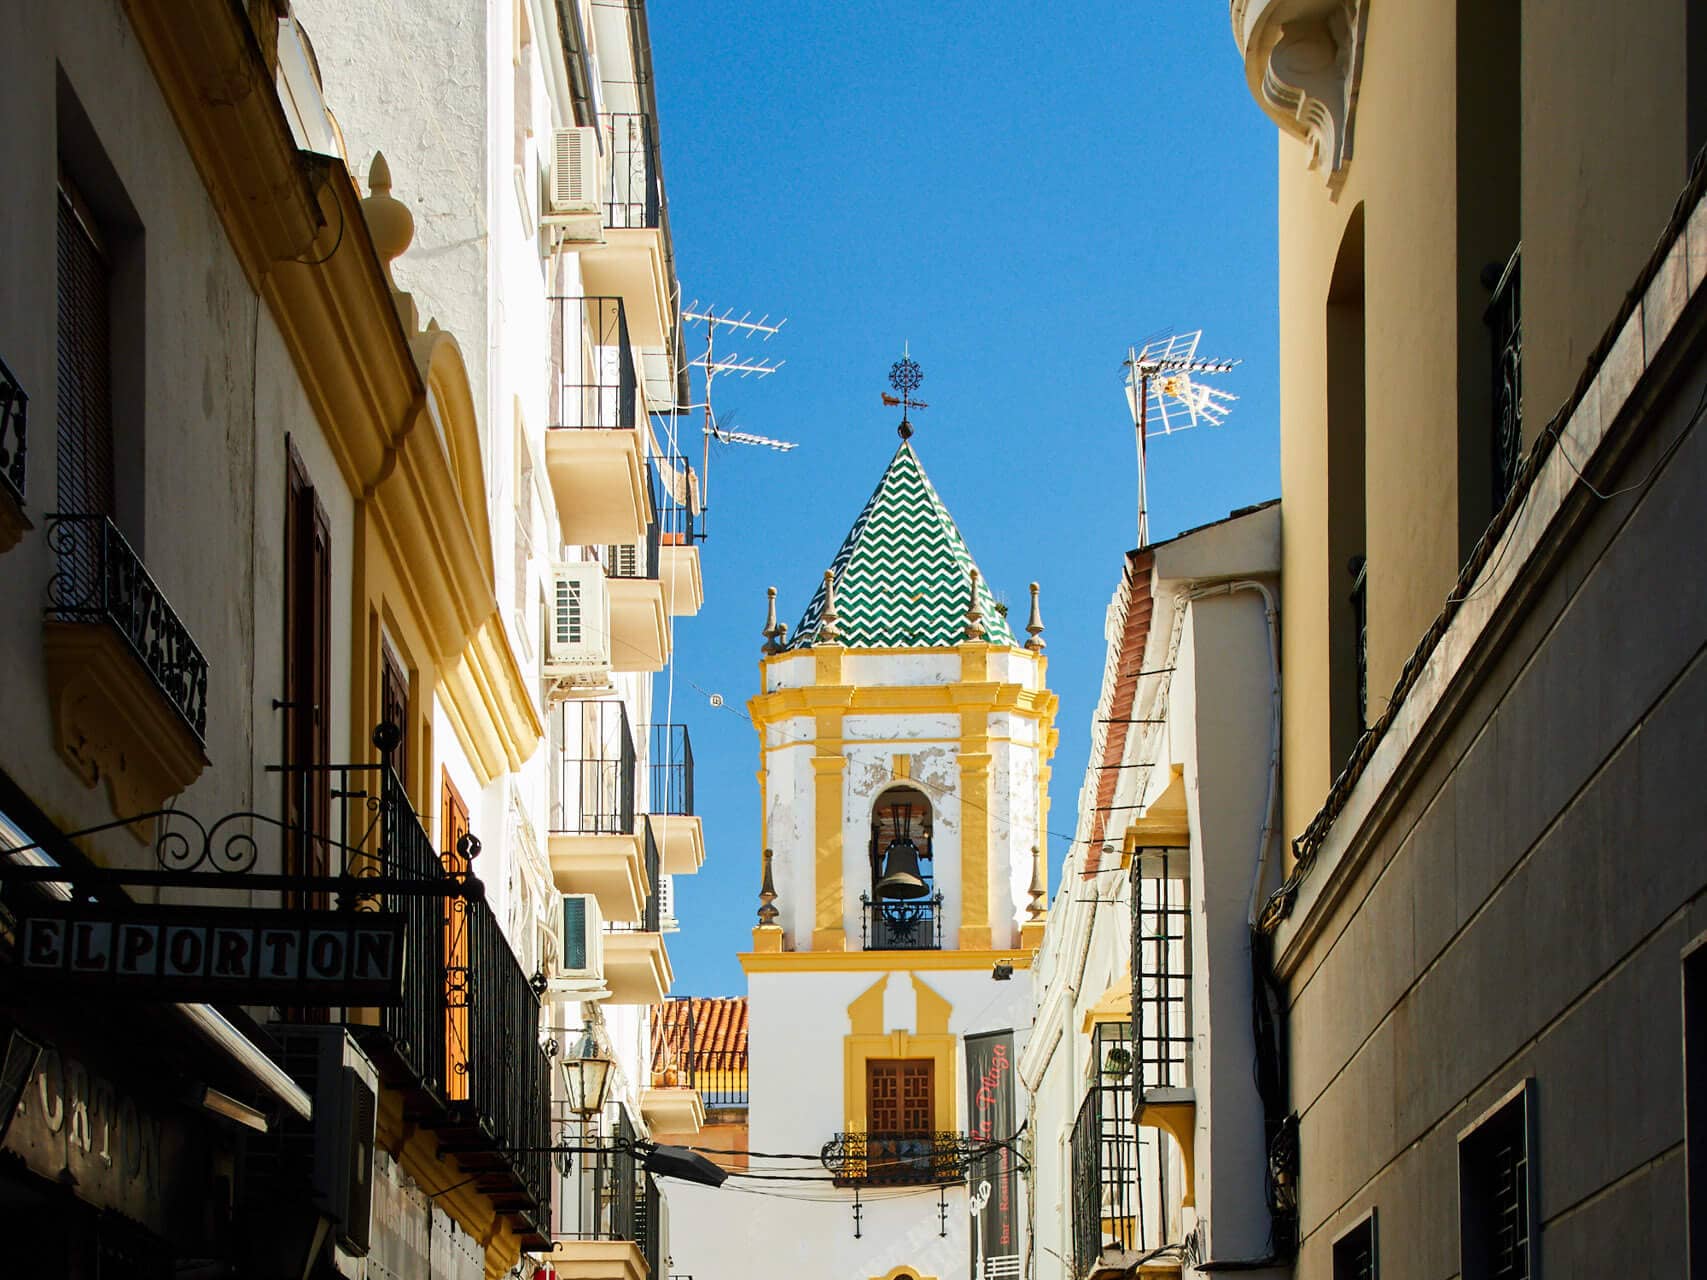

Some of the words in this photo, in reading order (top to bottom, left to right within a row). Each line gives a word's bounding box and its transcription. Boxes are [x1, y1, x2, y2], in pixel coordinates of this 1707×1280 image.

[975, 1043, 1010, 1112] Plaza
[969, 1120, 993, 1147] La
[999, 1223, 1011, 1246] Bar
